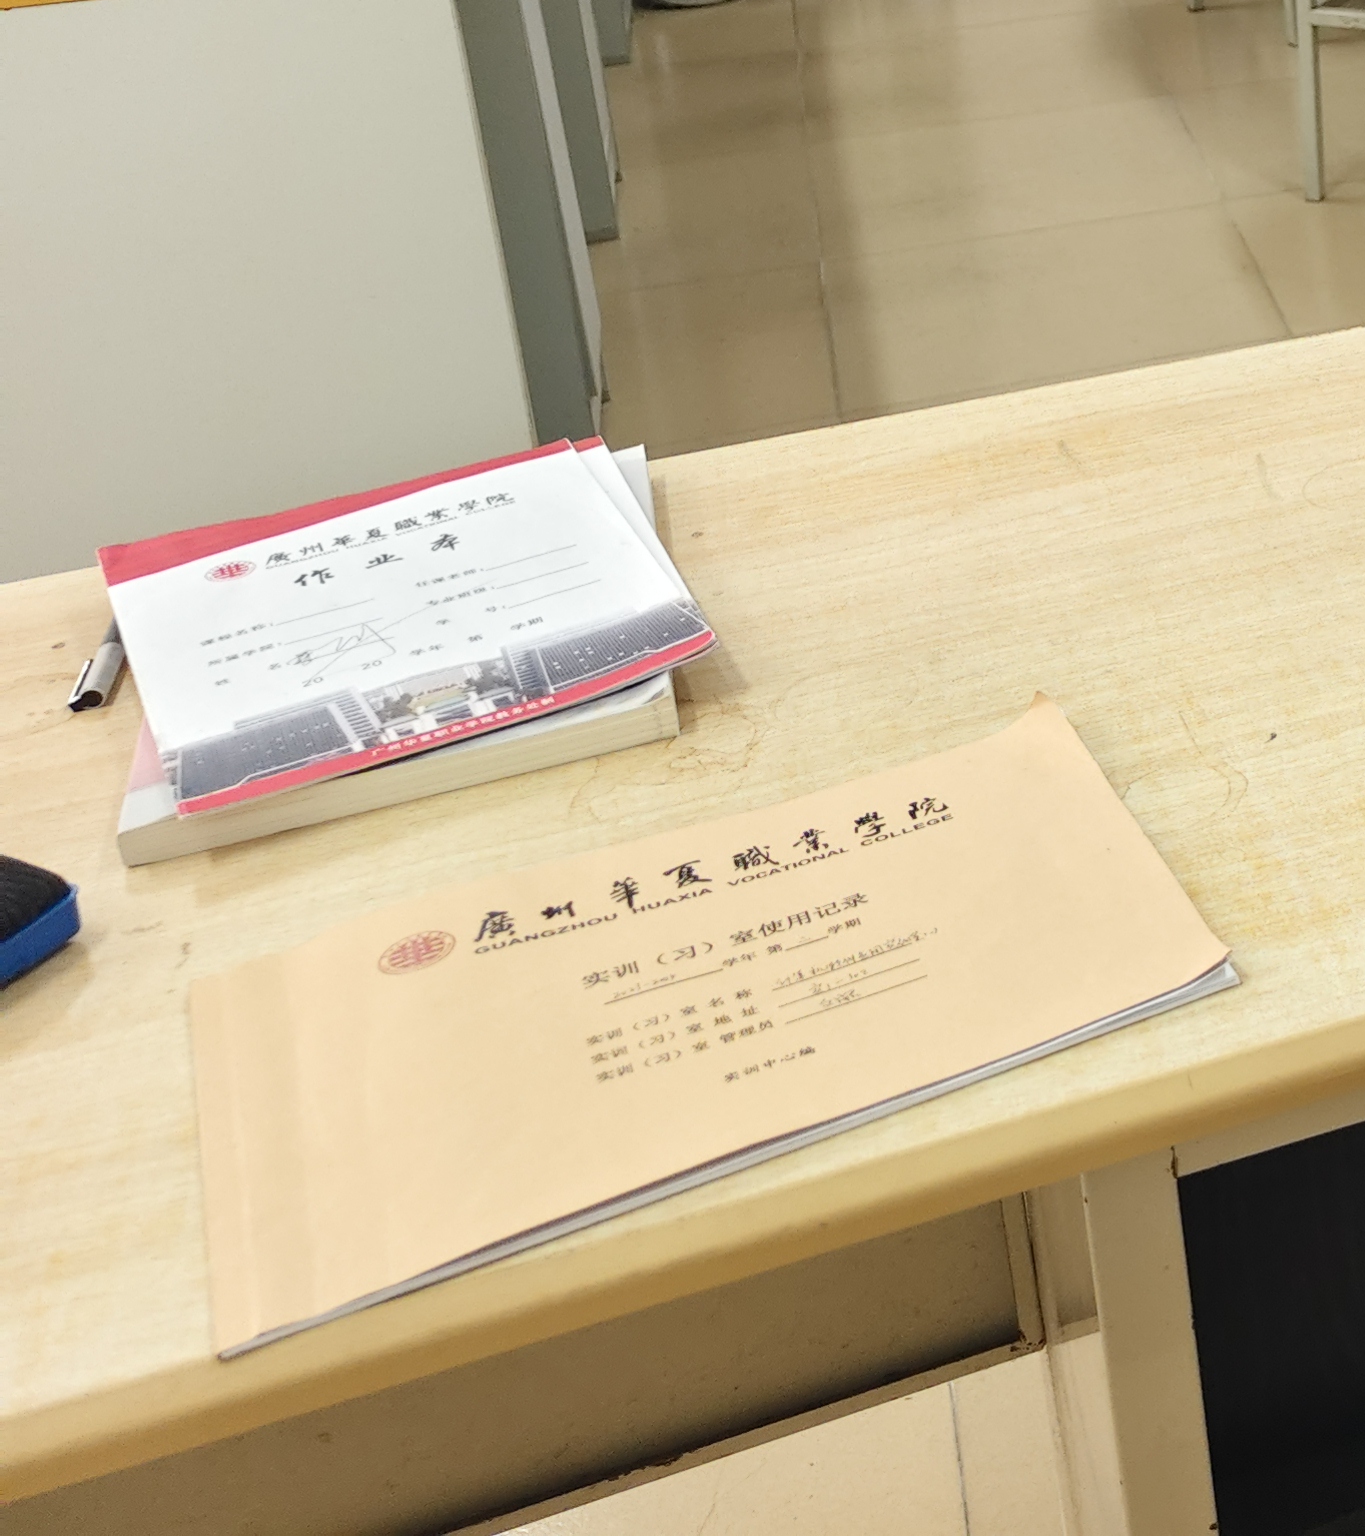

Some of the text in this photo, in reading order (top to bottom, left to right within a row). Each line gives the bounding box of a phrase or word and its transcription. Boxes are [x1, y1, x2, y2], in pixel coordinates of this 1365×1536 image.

[474, 912, 618, 954] GUANGZHOU
[632, 888, 713, 914] HUAXIA
[727, 847, 849, 886] VOCATIONAL
[860, 813, 954, 847] COLLEGE
[582, 892, 869, 990] 实训（习）室使用记录
